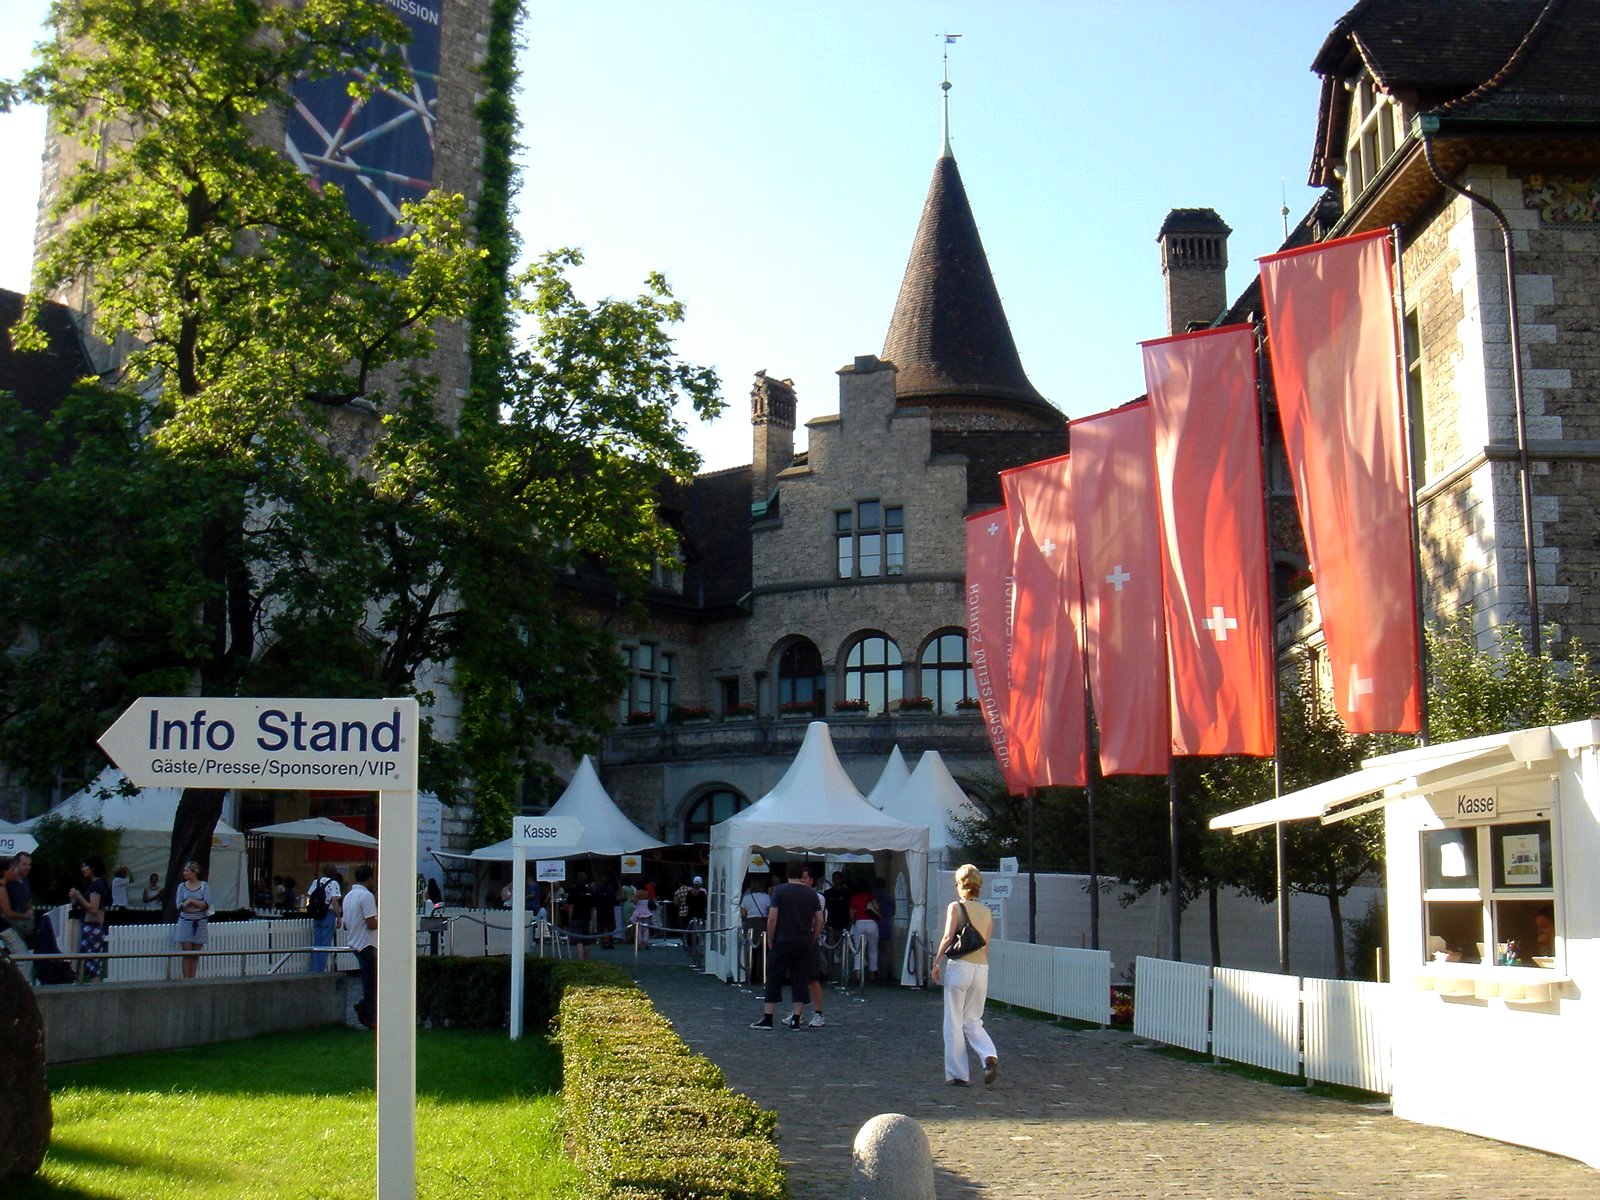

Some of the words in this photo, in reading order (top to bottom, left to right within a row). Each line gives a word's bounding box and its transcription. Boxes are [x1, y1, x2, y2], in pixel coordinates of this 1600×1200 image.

[969, 583, 982, 644] ZÜRICH
[975, 649, 1009, 768] NDESMUSEUM
[149, 709, 235, 750] Info
[256, 709, 401, 753] Stand
[151, 758, 396, 777] Gäste/Presse/Sponsoren/VIP
[1457, 794, 1494, 814] Kasse
[523, 824, 557, 838] Kasse
[0, 838, 15, 850] ng
